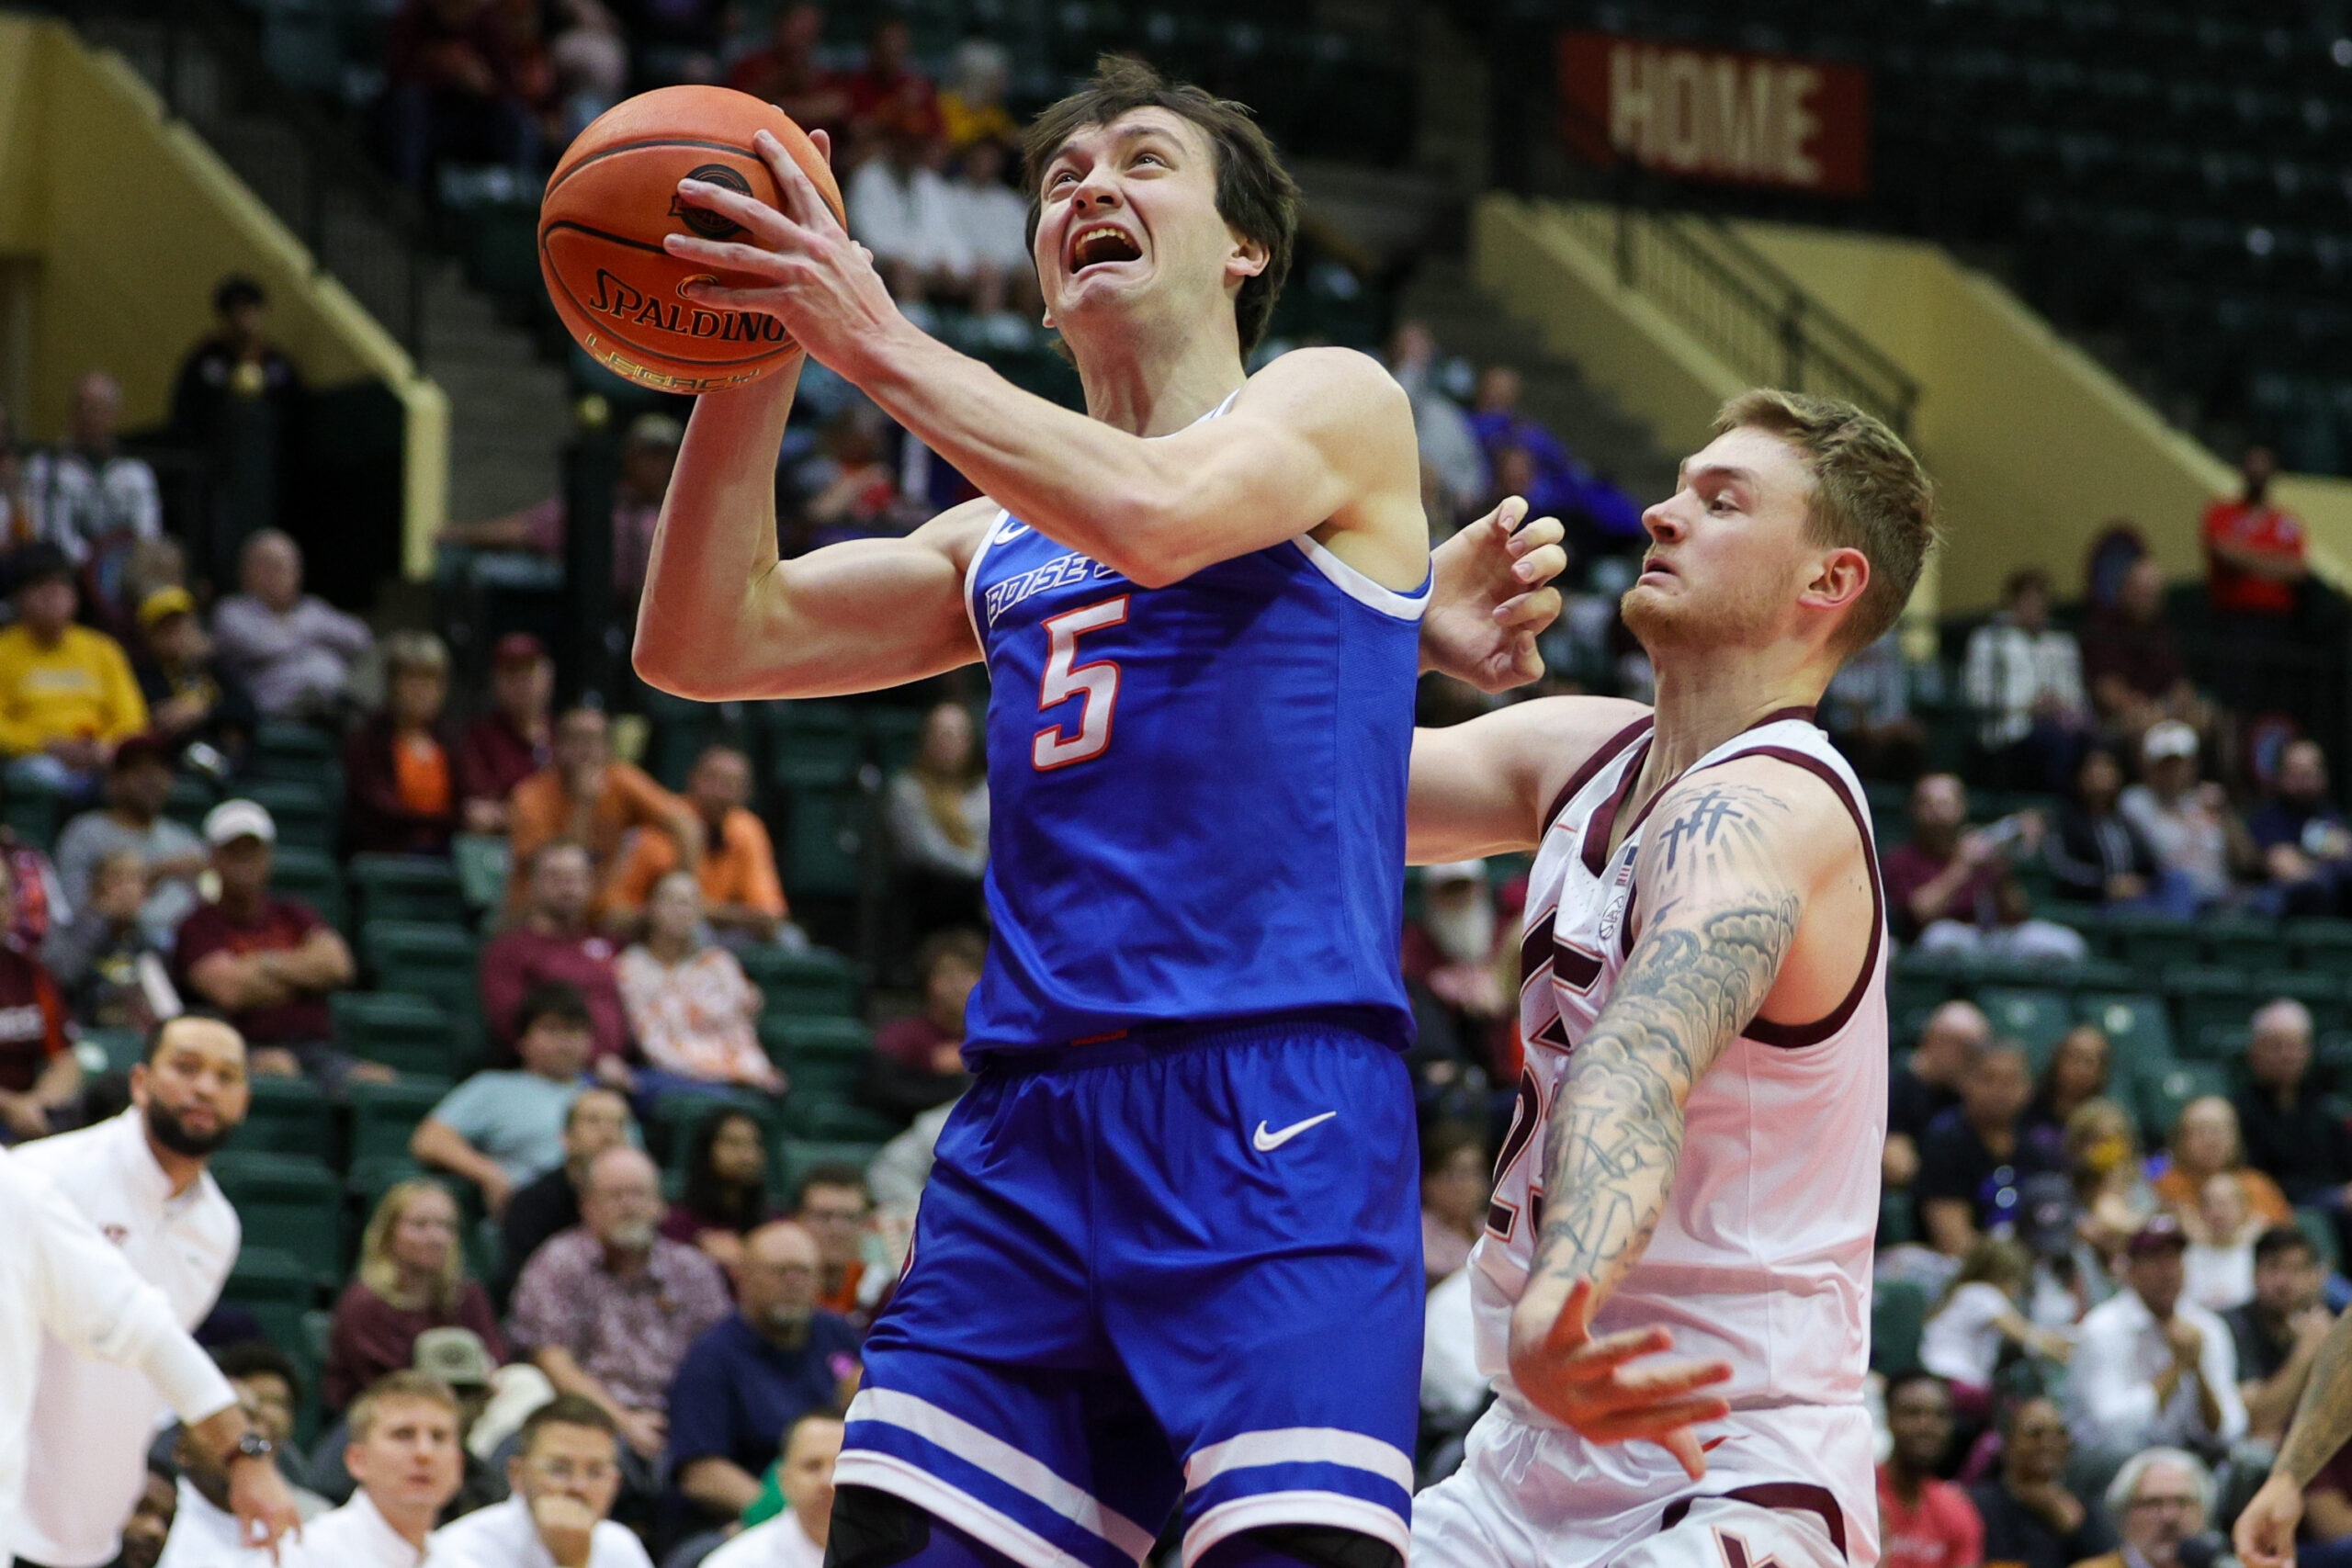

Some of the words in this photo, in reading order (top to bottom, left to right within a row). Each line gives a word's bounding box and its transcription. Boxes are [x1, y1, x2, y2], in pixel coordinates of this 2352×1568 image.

[1608, 40, 1824, 186] HOME
[585, 333, 761, 391] LEGACY
[985, 552, 1091, 627] BOISE
[1031, 593, 1131, 772] 5
